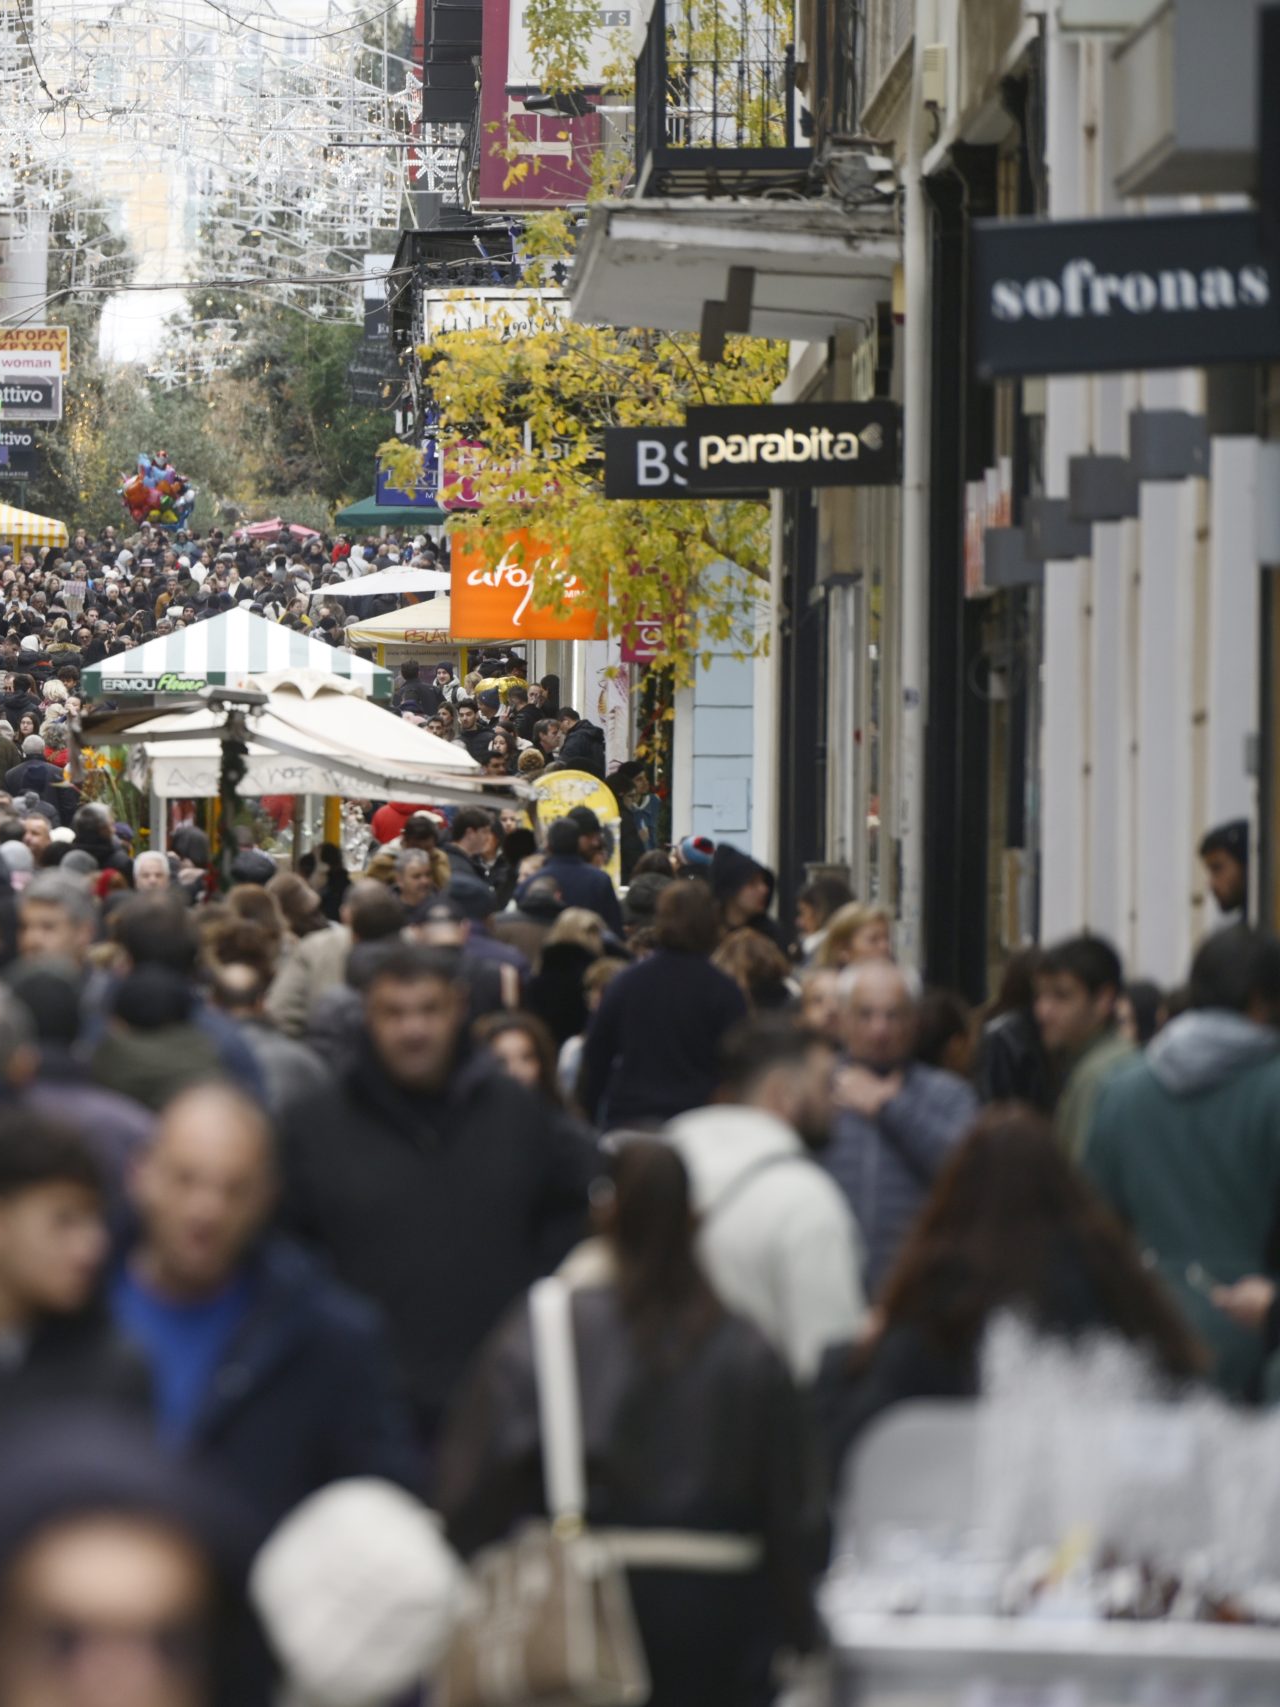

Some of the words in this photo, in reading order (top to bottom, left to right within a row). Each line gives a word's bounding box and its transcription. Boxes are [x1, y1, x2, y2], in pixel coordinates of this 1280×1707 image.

[991, 257, 1270, 321] sofronas
[4, 330, 59, 340] ΑΓΟΡΑ
[2, 359, 52, 368] woman
[699, 426, 859, 470] parabita
[102, 679, 156, 690] ERMOU
